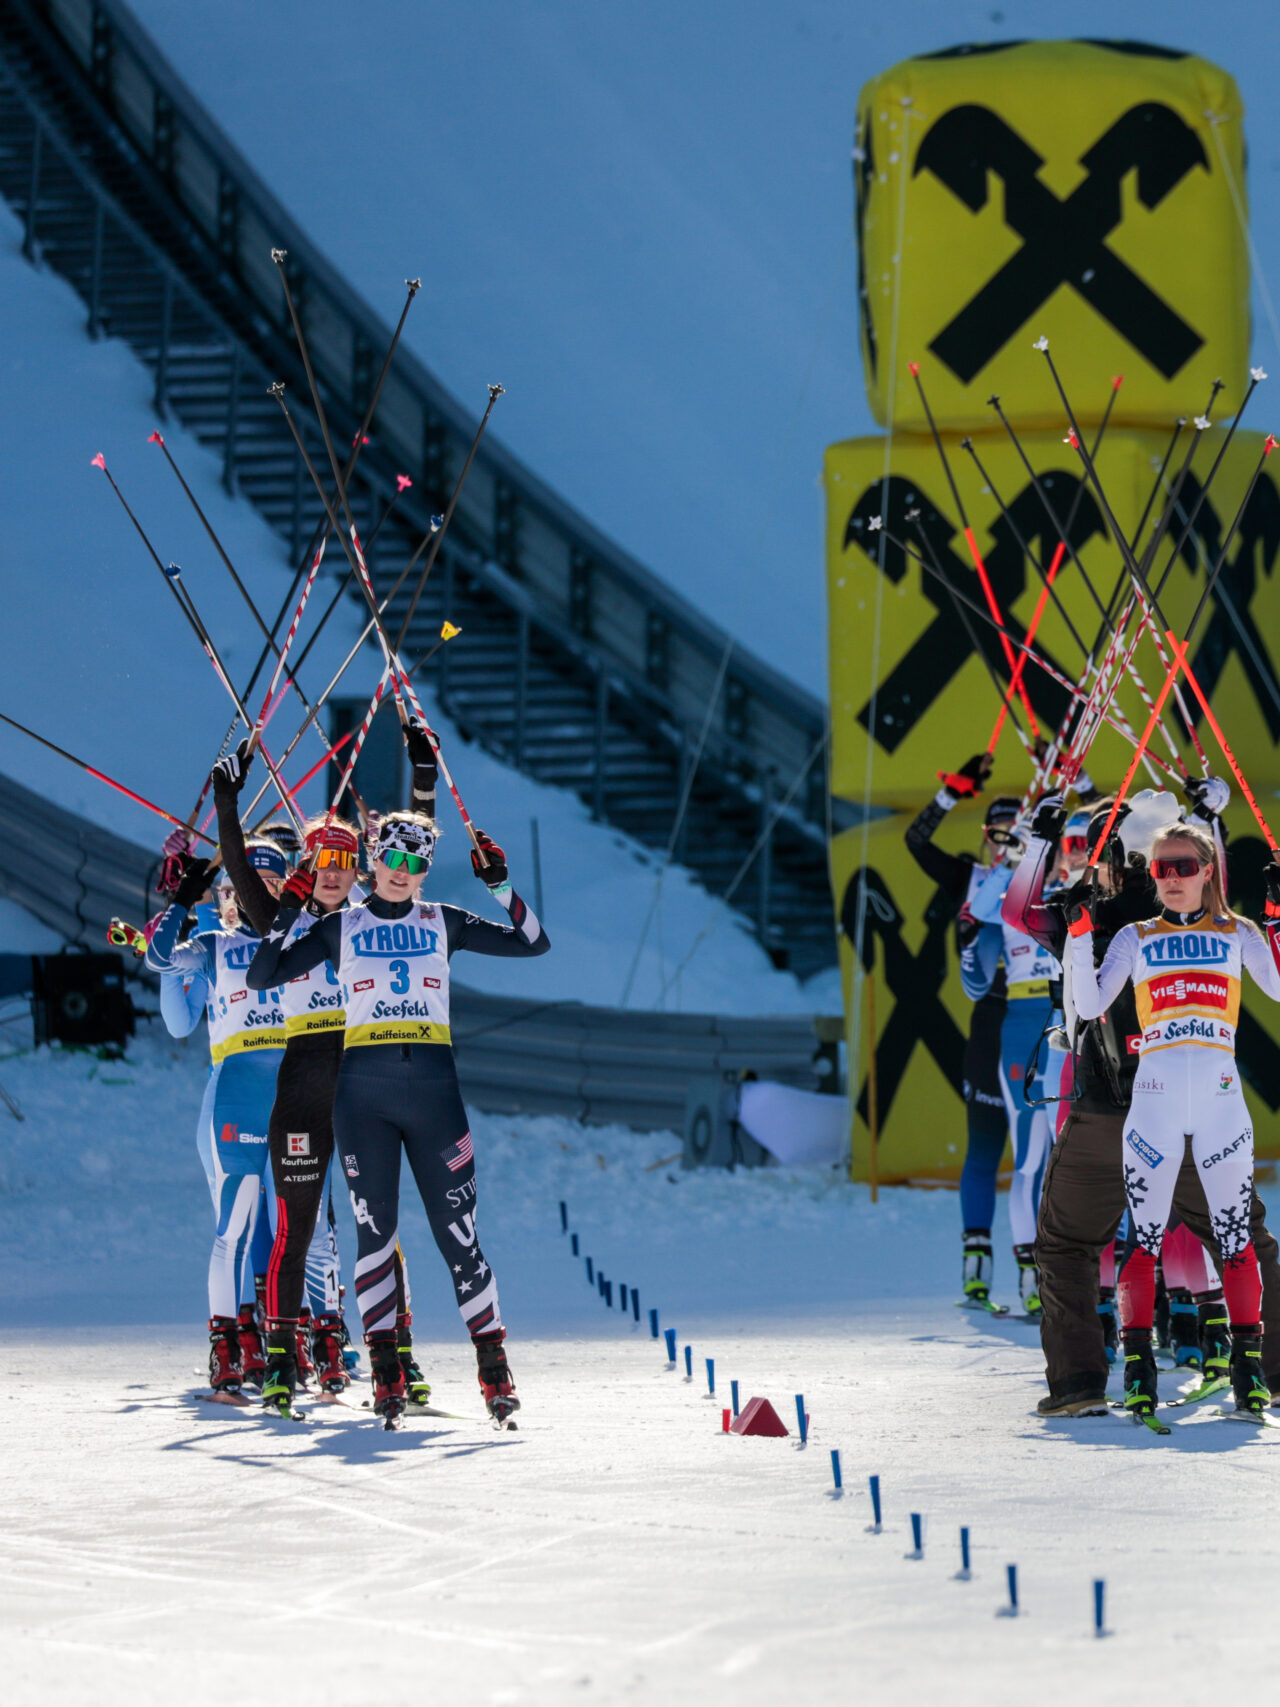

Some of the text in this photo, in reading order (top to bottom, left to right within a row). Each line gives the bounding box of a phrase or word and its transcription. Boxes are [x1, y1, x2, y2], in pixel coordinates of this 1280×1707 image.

[351, 924, 438, 954] TYROLIT
[1142, 934, 1230, 962] TYROLIT
[389, 960, 410, 994] 3
[1152, 980, 1226, 999] VIESSMANN
[308, 991, 342, 1009] Seef
[372, 1000, 429, 1018] Seefeld
[244, 1008, 284, 1026] Seefe
[307, 1018, 346, 1030] Raiffeise
[370, 1029, 417, 1041] Raiffeisen
[1164, 1019, 1214, 1040] Seefeld
[239, 1133, 268, 1144] Sievi
[1202, 1133, 1247, 1169] CRAFT
[281, 1157, 318, 1167] Kaufland
[292, 1172, 320, 1182] TERREX
